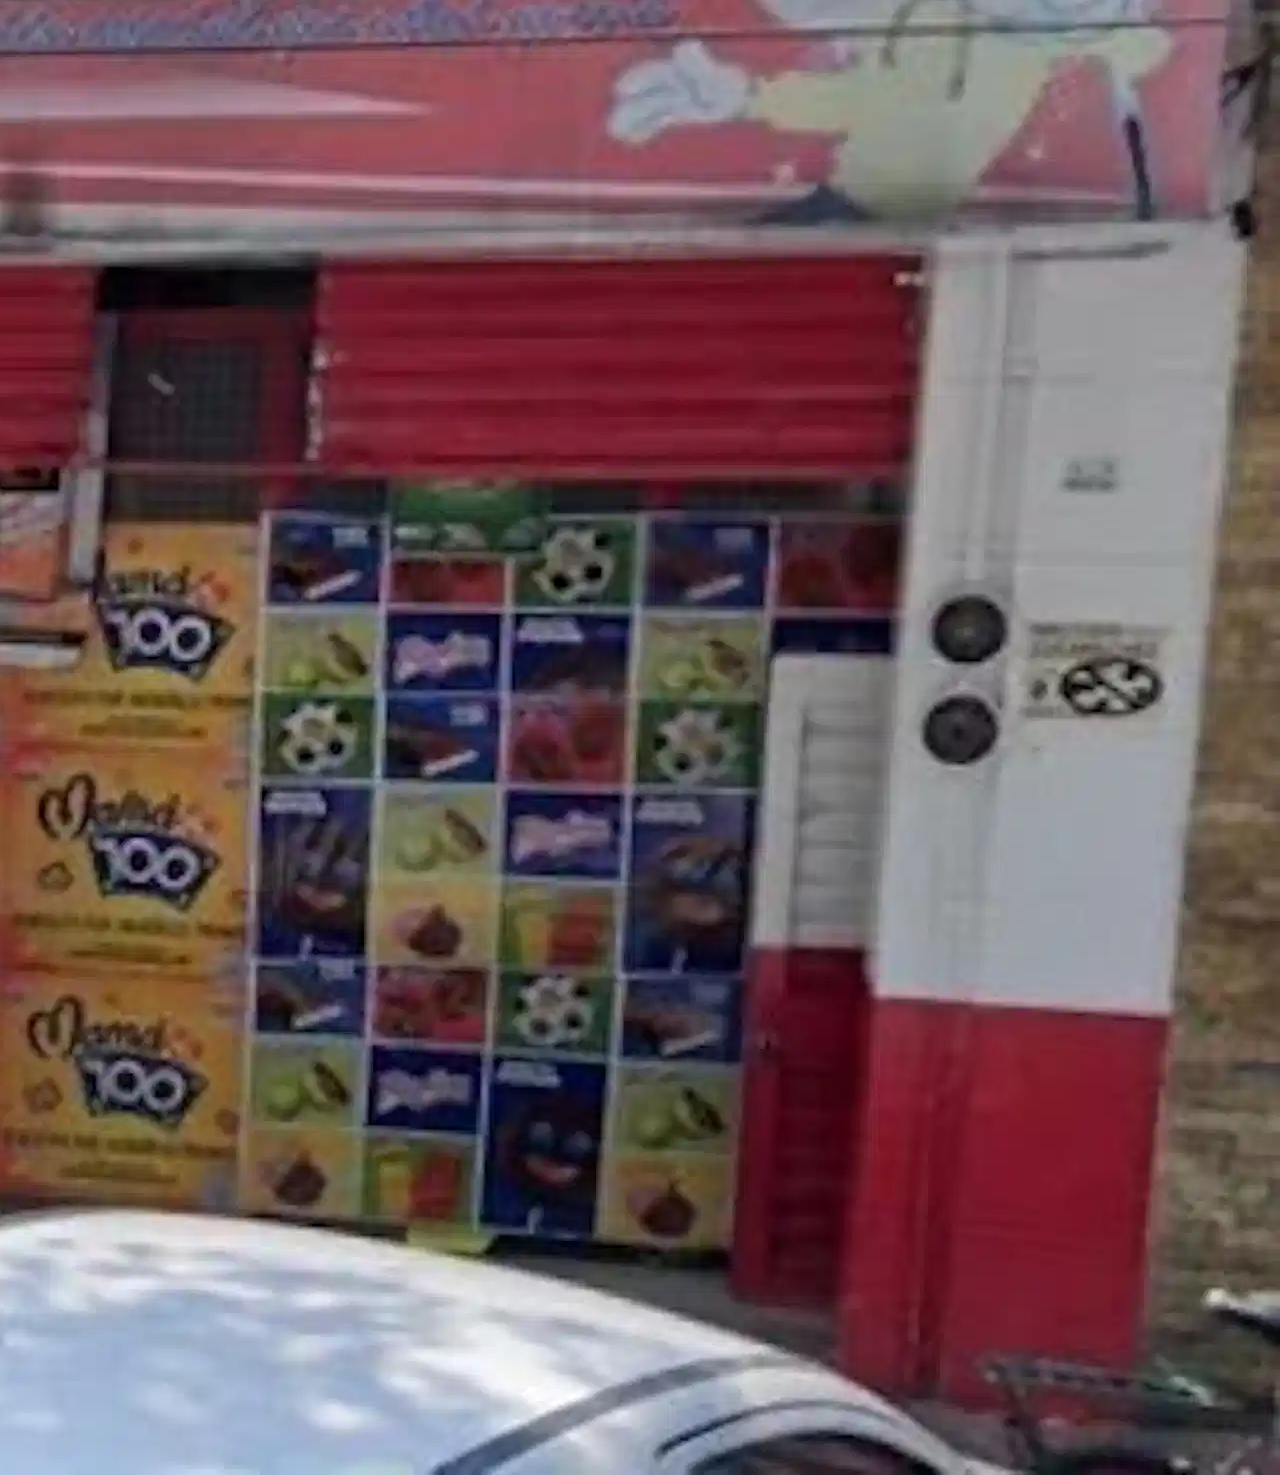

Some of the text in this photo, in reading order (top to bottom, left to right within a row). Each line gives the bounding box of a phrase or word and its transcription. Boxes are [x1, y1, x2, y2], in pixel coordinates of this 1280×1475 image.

[100, 606, 212, 663] 100
[93, 835, 201, 892] 100
[82, 1057, 188, 1113] 100
